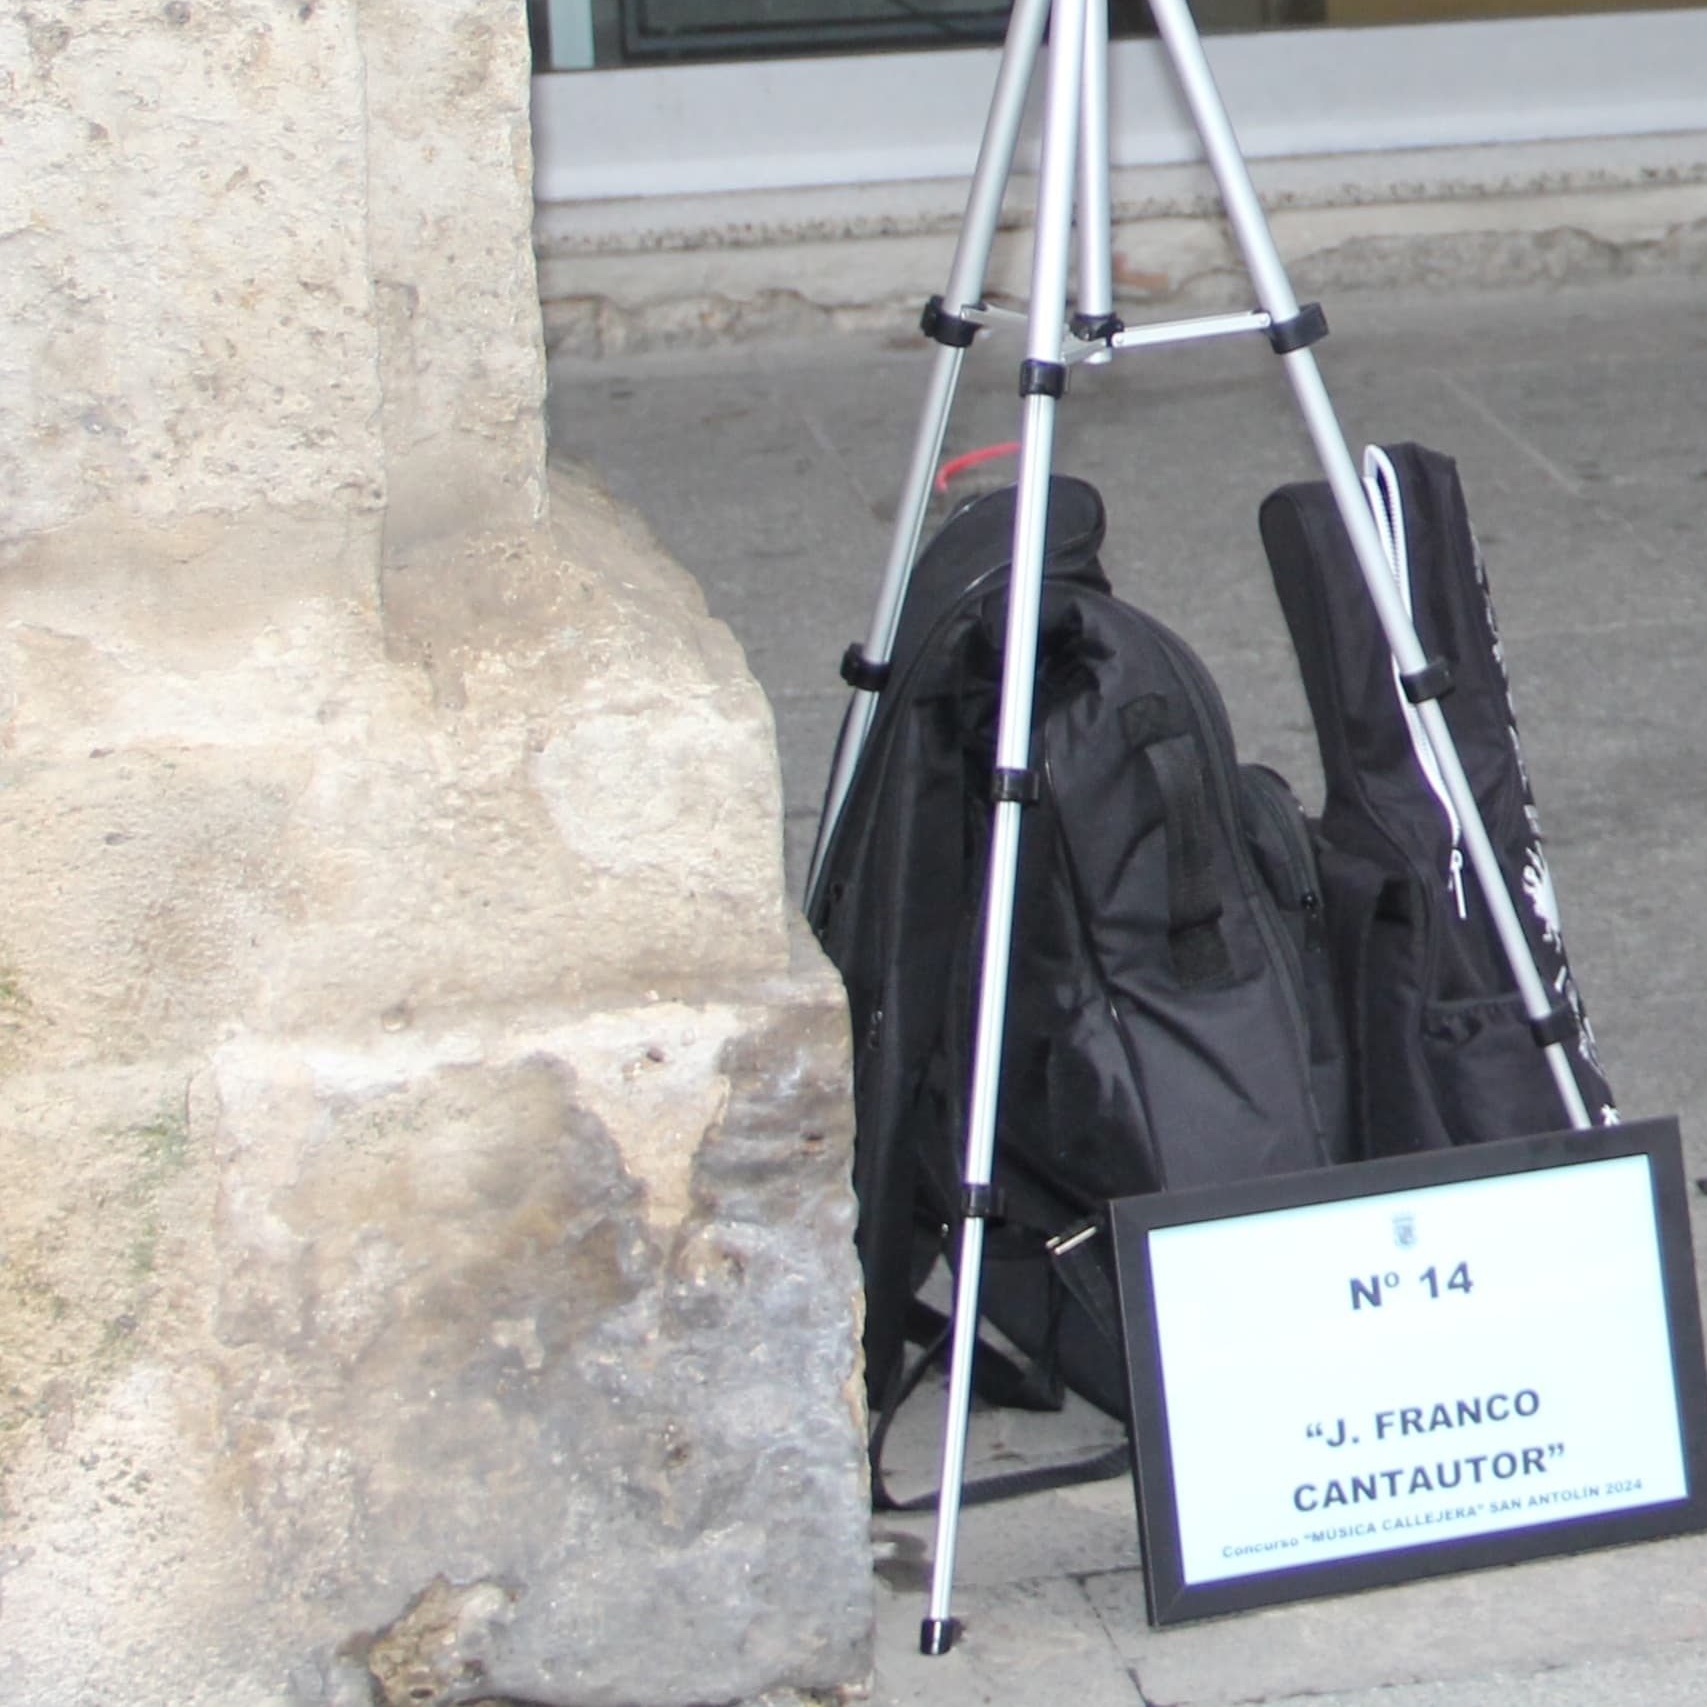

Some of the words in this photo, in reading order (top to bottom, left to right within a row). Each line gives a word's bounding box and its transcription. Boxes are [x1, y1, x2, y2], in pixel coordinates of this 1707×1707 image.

[1349, 1270, 1400, 1311] Nº
[1421, 1261, 1475, 1300] 14
[1375, 1387, 1542, 1441] FRANCO
[1222, 1535, 1299, 1559] Concurso
[1489, 1497, 1523, 1515] SAN
[1527, 1483, 1601, 1509] ANTOLÍN
[1605, 1477, 1644, 1496] 2024
